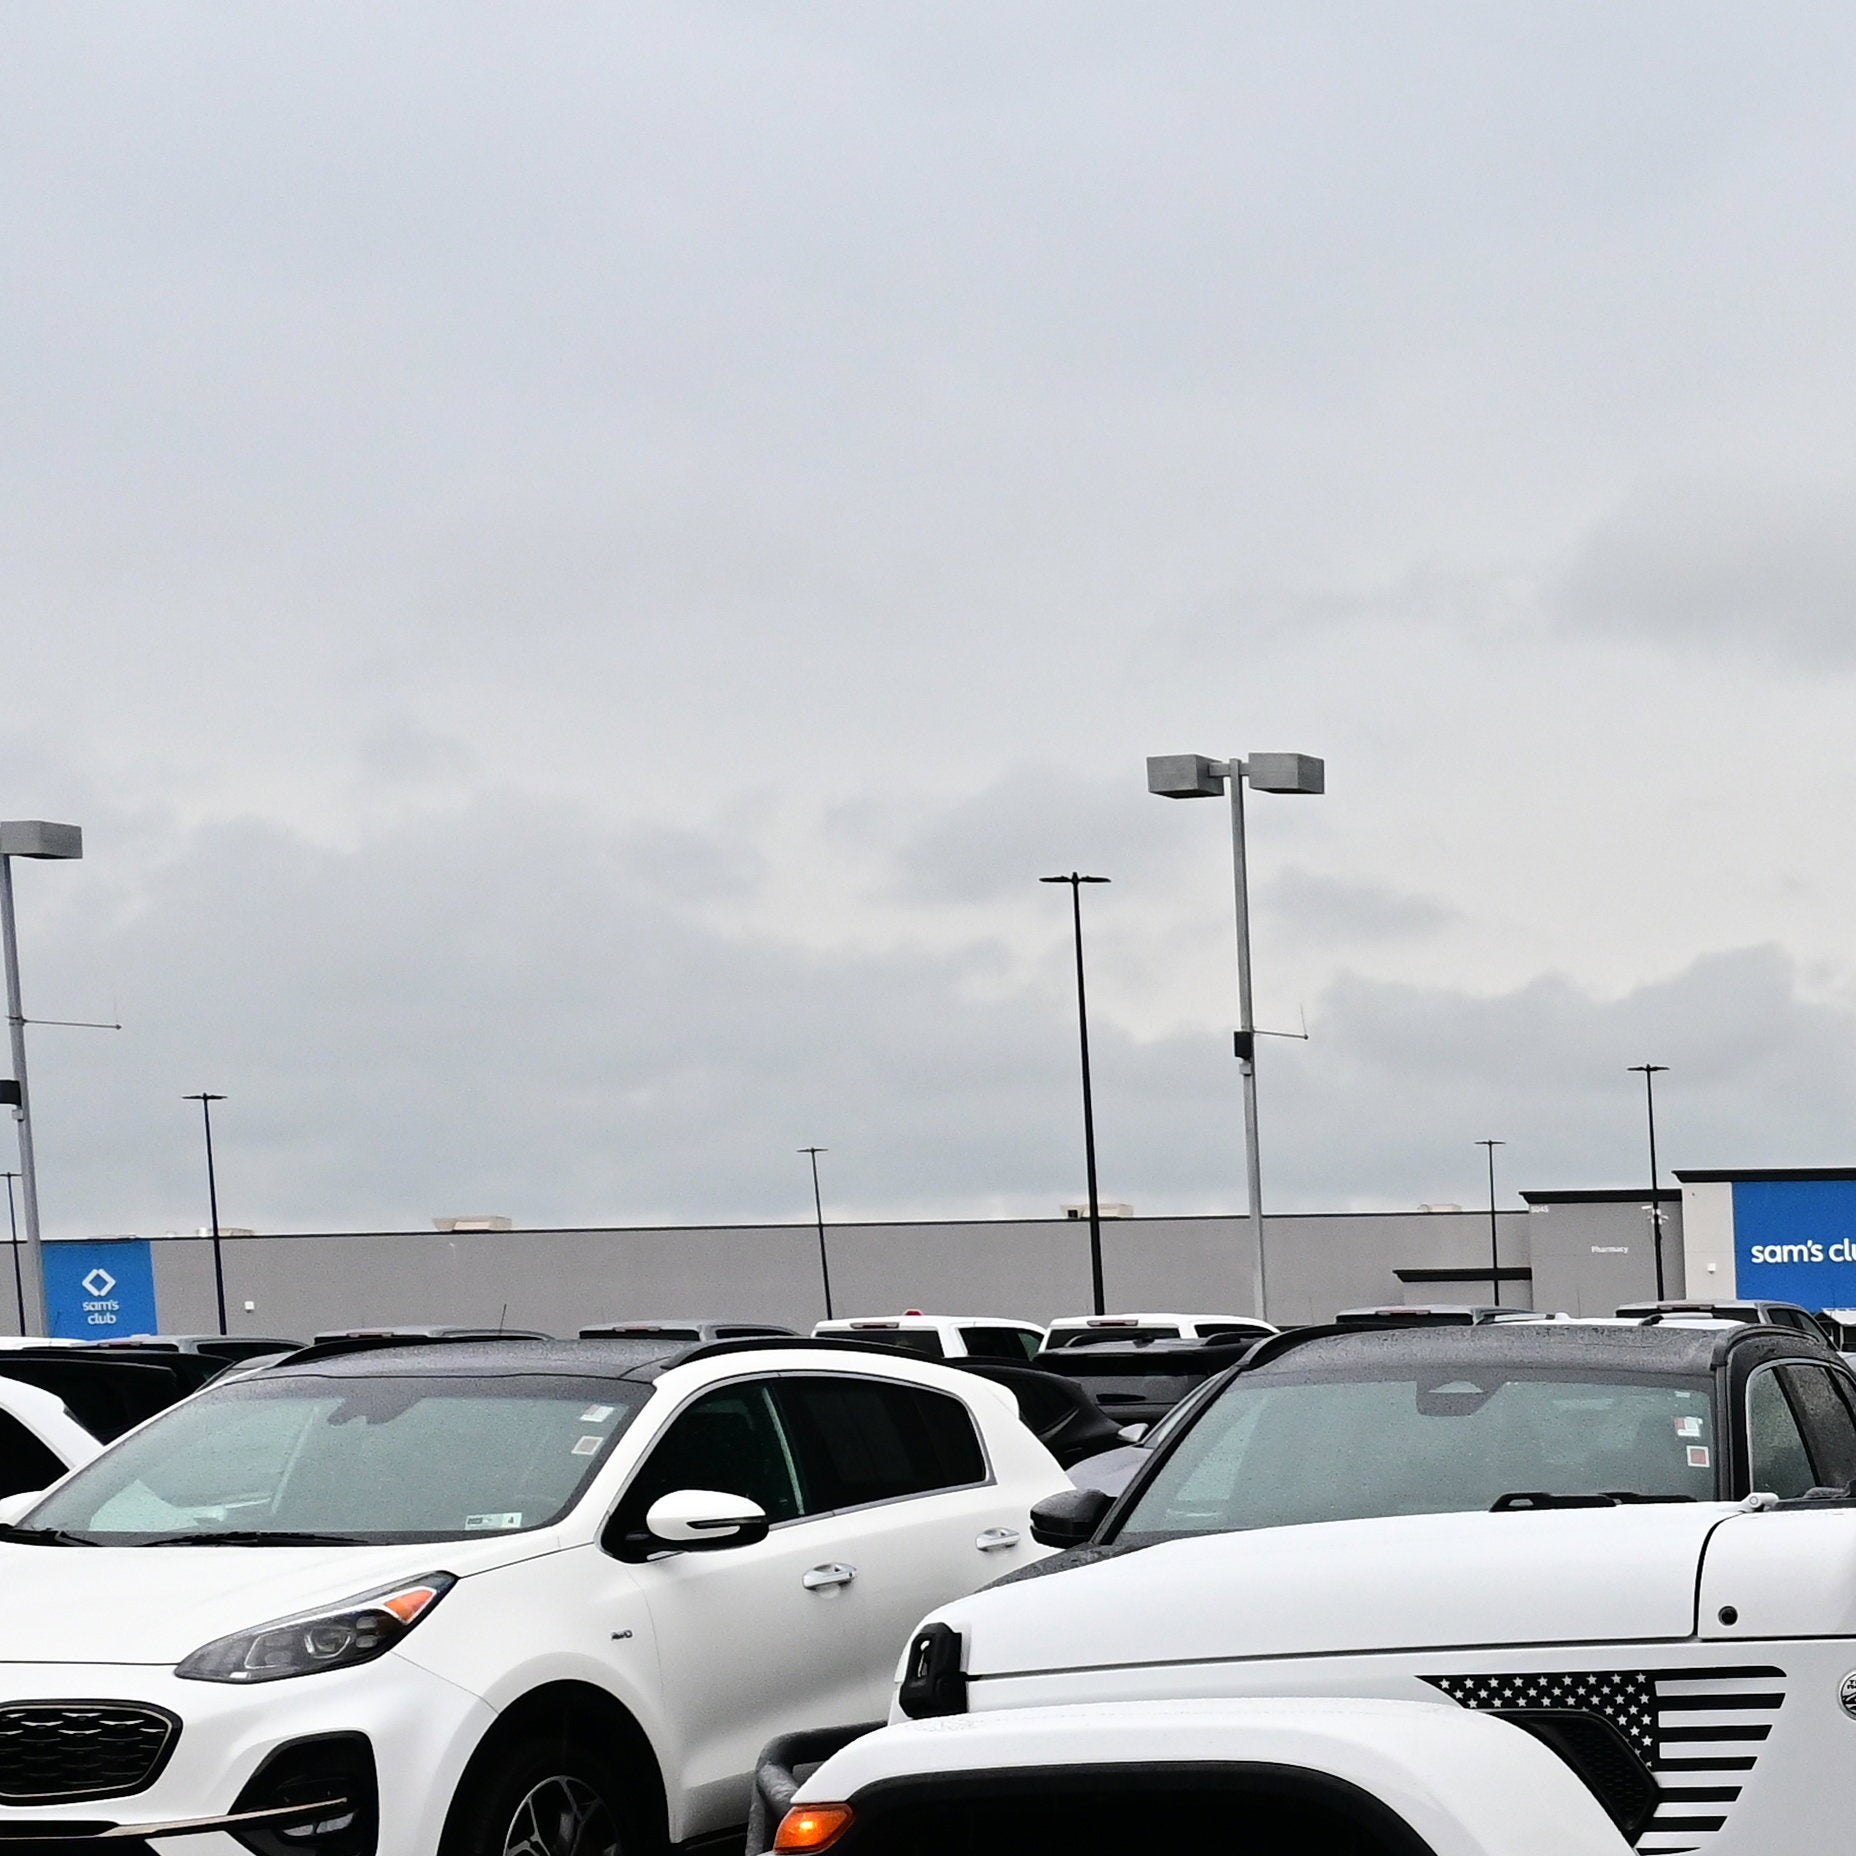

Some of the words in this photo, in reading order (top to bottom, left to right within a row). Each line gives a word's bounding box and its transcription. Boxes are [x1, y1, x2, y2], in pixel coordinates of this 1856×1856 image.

[1751, 1240, 1824, 1264] sam's
[82, 1300, 119, 1311] sam's
[87, 1312, 117, 1325] club
